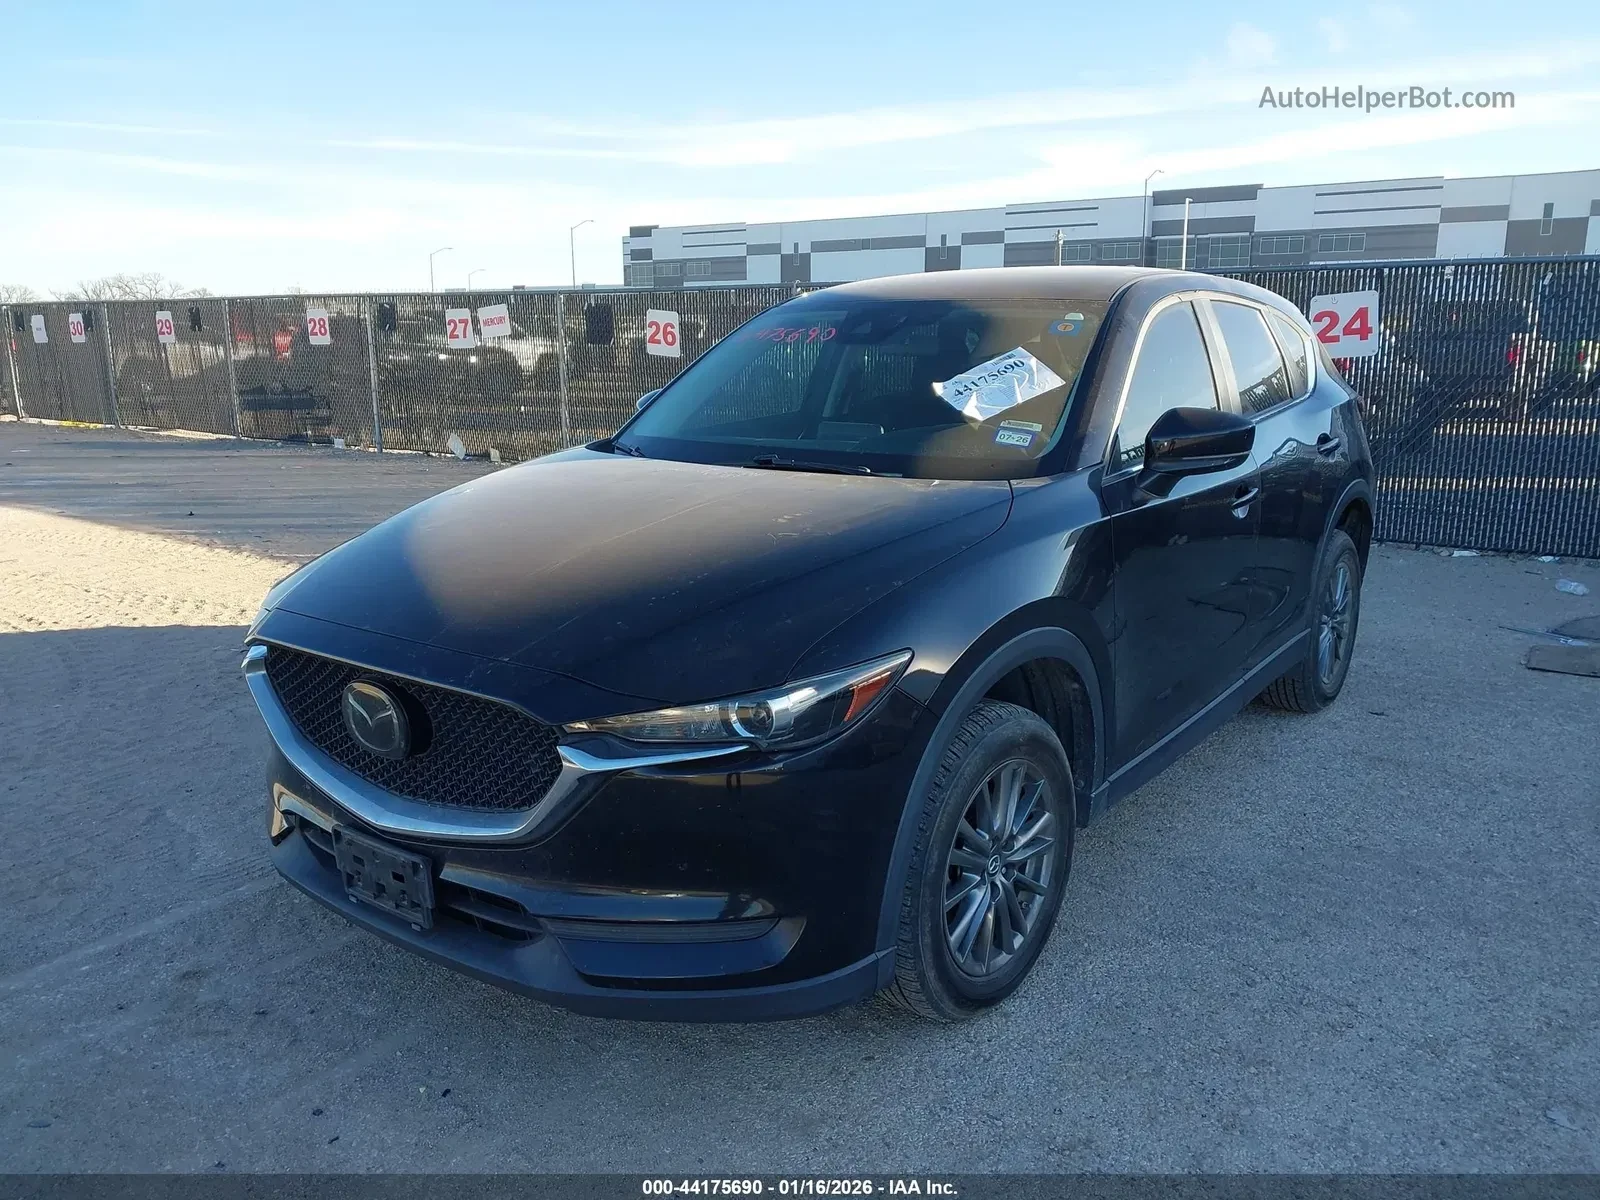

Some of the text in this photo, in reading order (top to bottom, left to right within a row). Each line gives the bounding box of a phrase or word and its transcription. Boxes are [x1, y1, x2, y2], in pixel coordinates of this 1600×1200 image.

[71, 321, 83, 336] 30
[157, 319, 172, 336] 29
[308, 317, 328, 337] 28
[447, 318, 469, 339] 27
[482, 315, 506, 327] MERCURY
[1312, 306, 1374, 344] 24
[647, 320, 677, 347] 26
[954, 359, 1025, 397] 44175690
